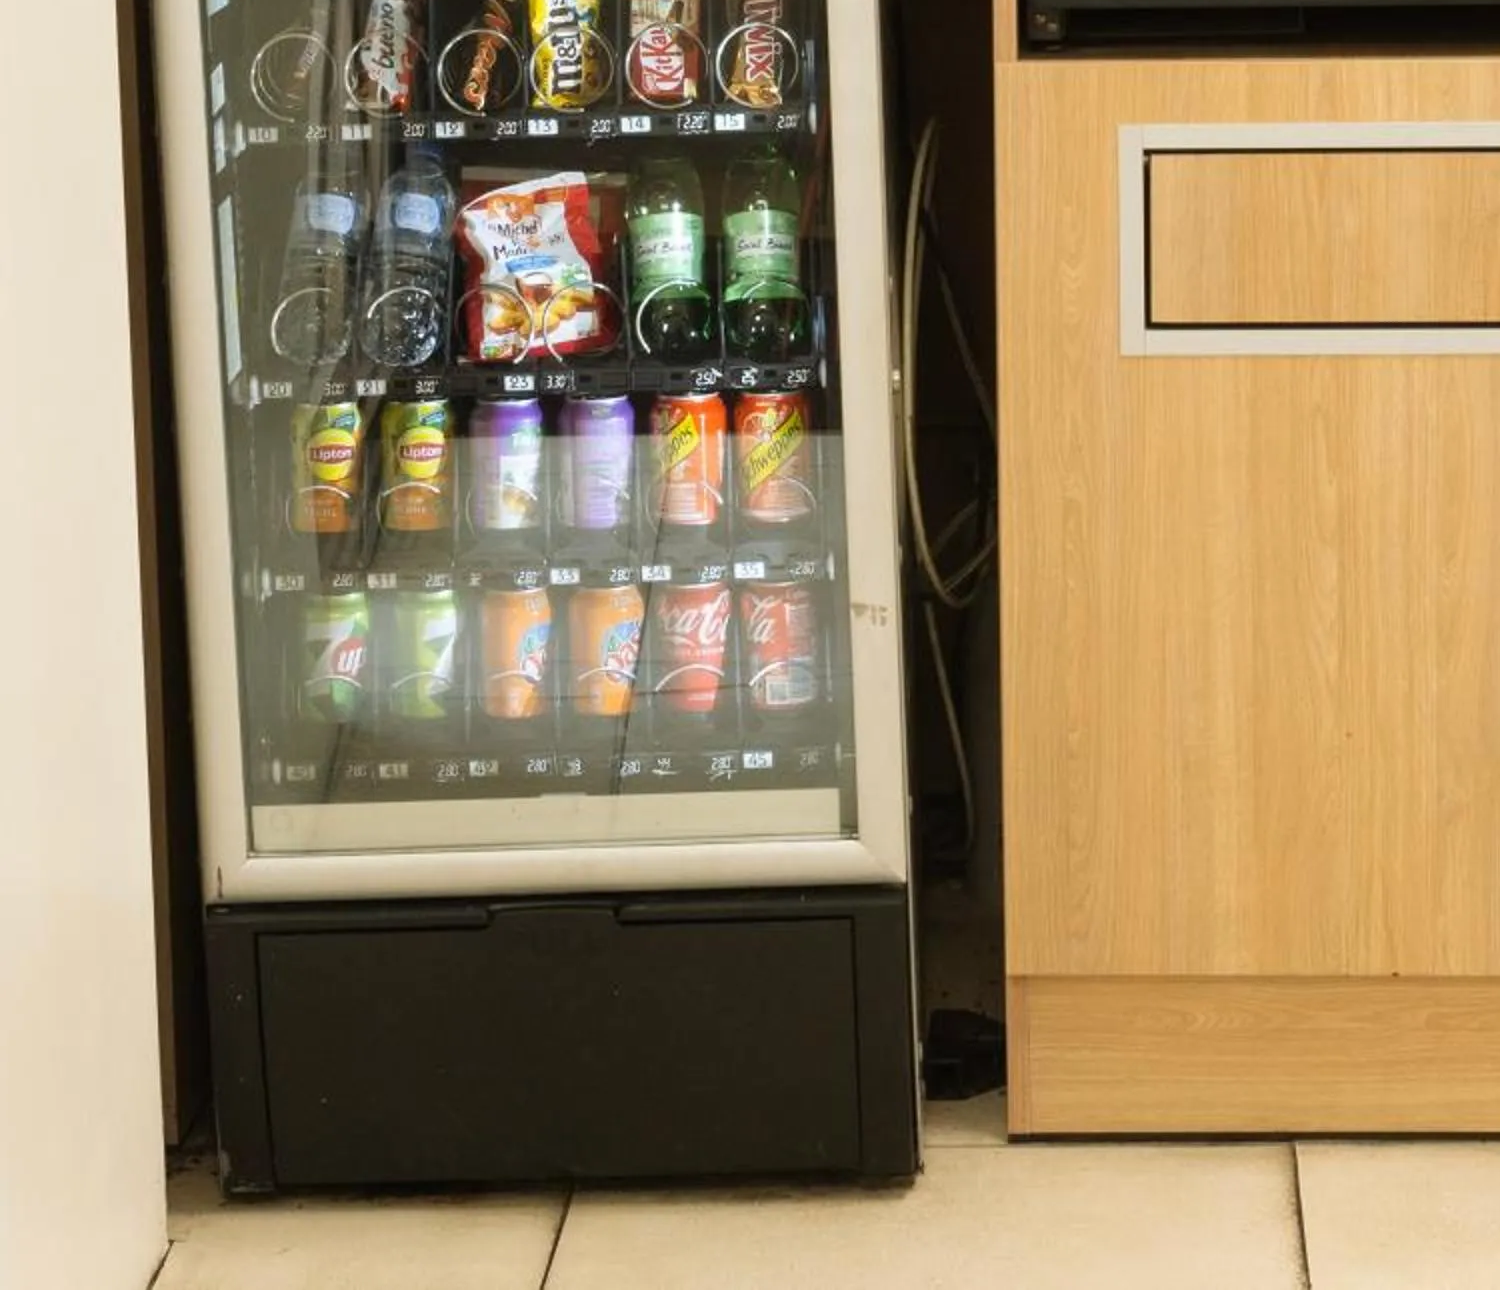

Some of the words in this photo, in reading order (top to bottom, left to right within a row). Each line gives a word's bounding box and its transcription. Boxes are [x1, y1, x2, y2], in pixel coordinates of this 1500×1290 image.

[372, 2, 395, 69] bueno
[312, 446, 353, 461] Lipton
[402, 444, 445, 459] Lipton
